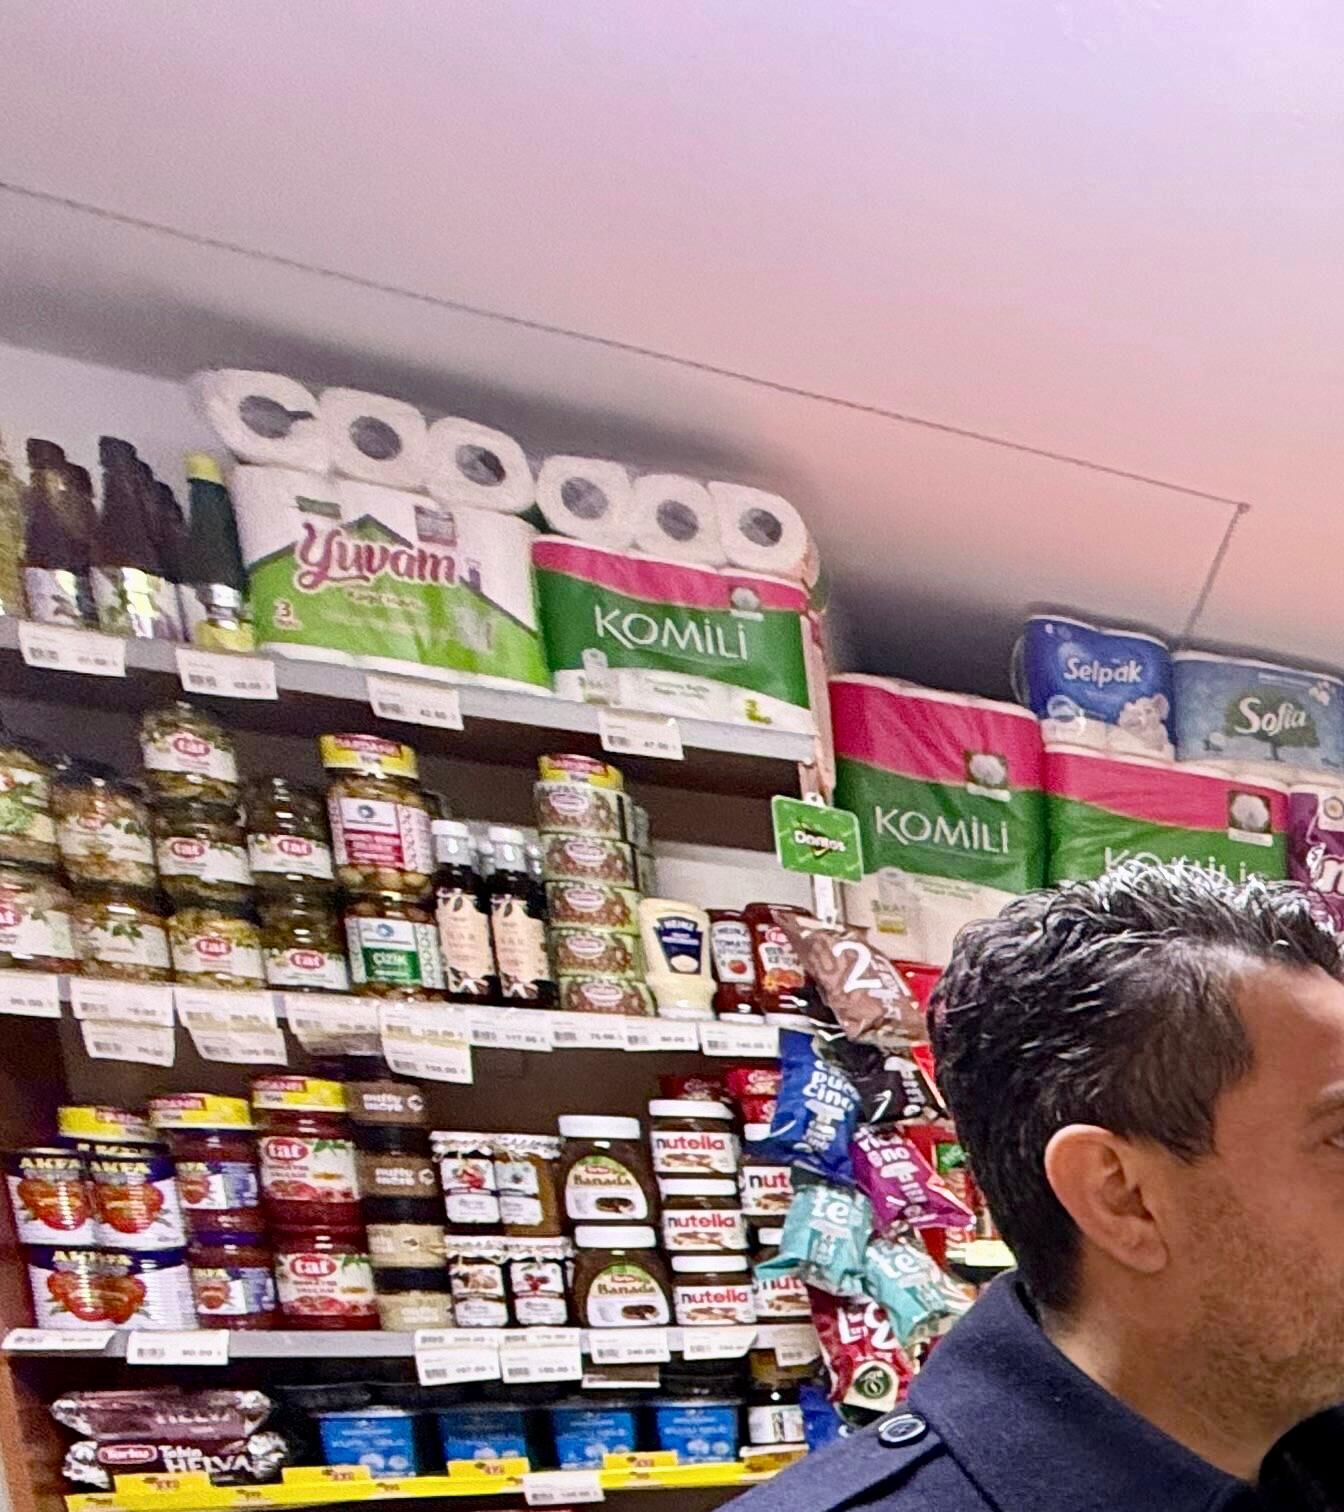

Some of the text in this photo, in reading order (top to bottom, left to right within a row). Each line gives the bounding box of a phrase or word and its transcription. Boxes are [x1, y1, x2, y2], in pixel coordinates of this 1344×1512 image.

[294, 522, 458, 589] Yuvam
[1063, 655, 1143, 688] Selpak
[1235, 697, 1307, 737] Sofia
[832, 940, 884, 994] 2
[656, 1135, 726, 1151] nutella
[667, 1213, 737, 1228] nutella
[680, 1289, 749, 1305] nutella
